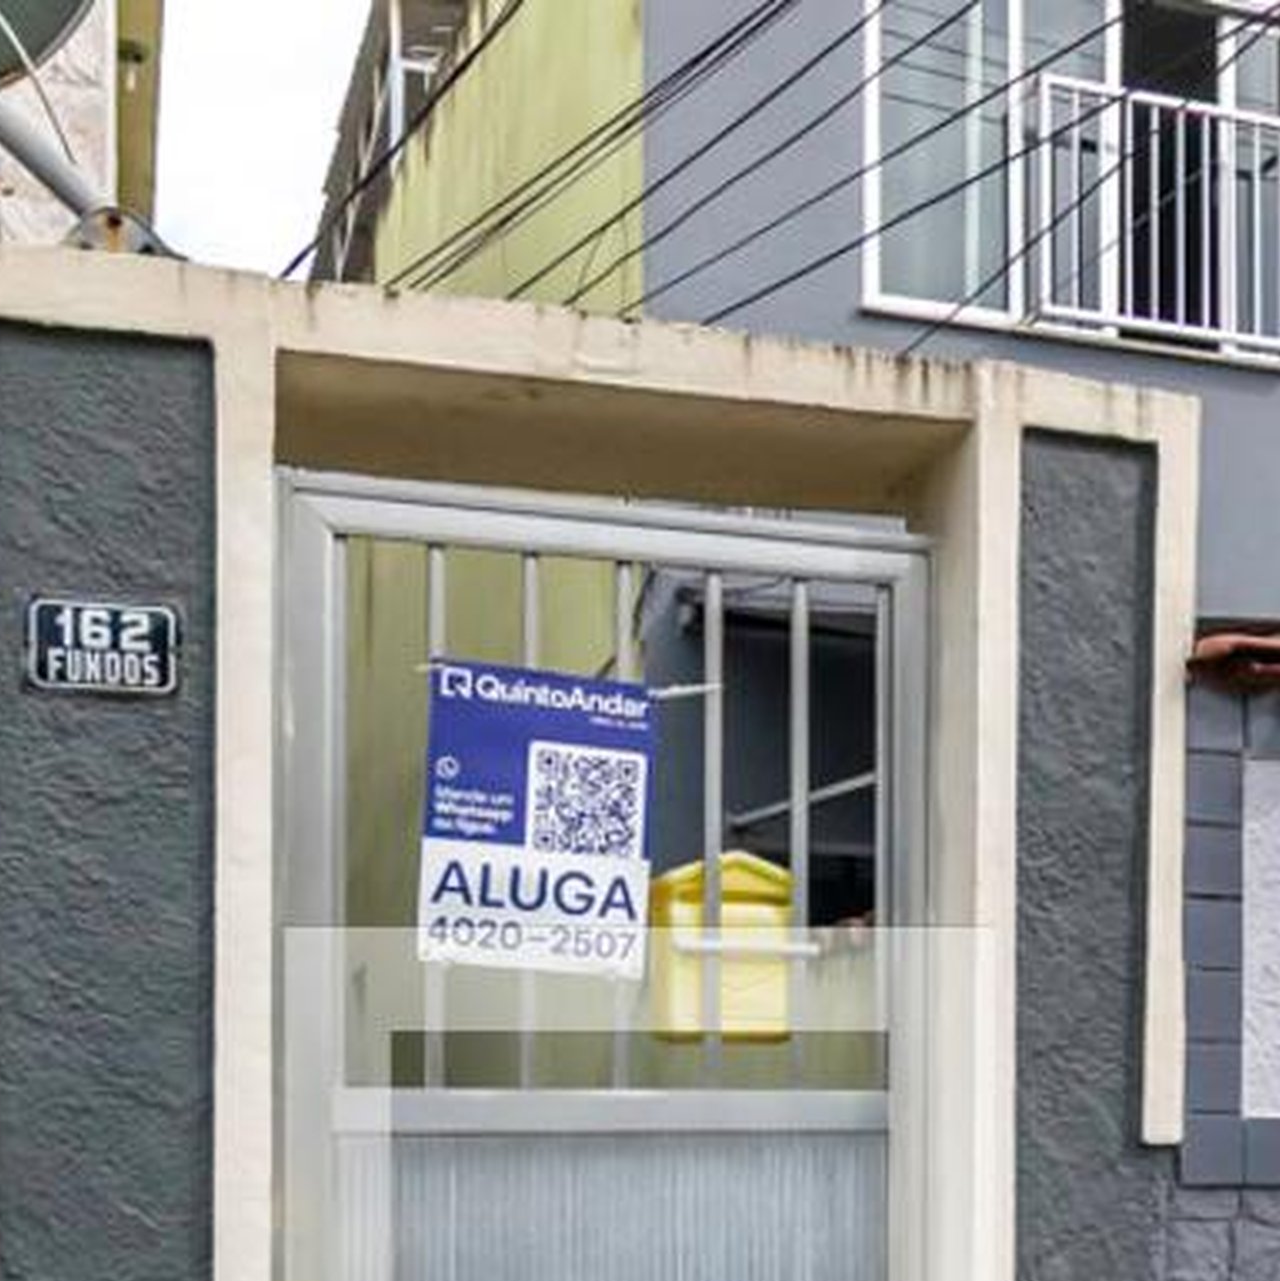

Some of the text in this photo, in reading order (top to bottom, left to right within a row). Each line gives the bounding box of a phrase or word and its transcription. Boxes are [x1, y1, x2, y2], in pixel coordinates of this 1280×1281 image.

[55, 607, 152, 651] 162
[48, 647, 160, 685] FUNDOS
[476, 674, 649, 717] QuintoAndar
[431, 860, 637, 921] ALUGA
[429, 915, 637, 960] 4020-2507
